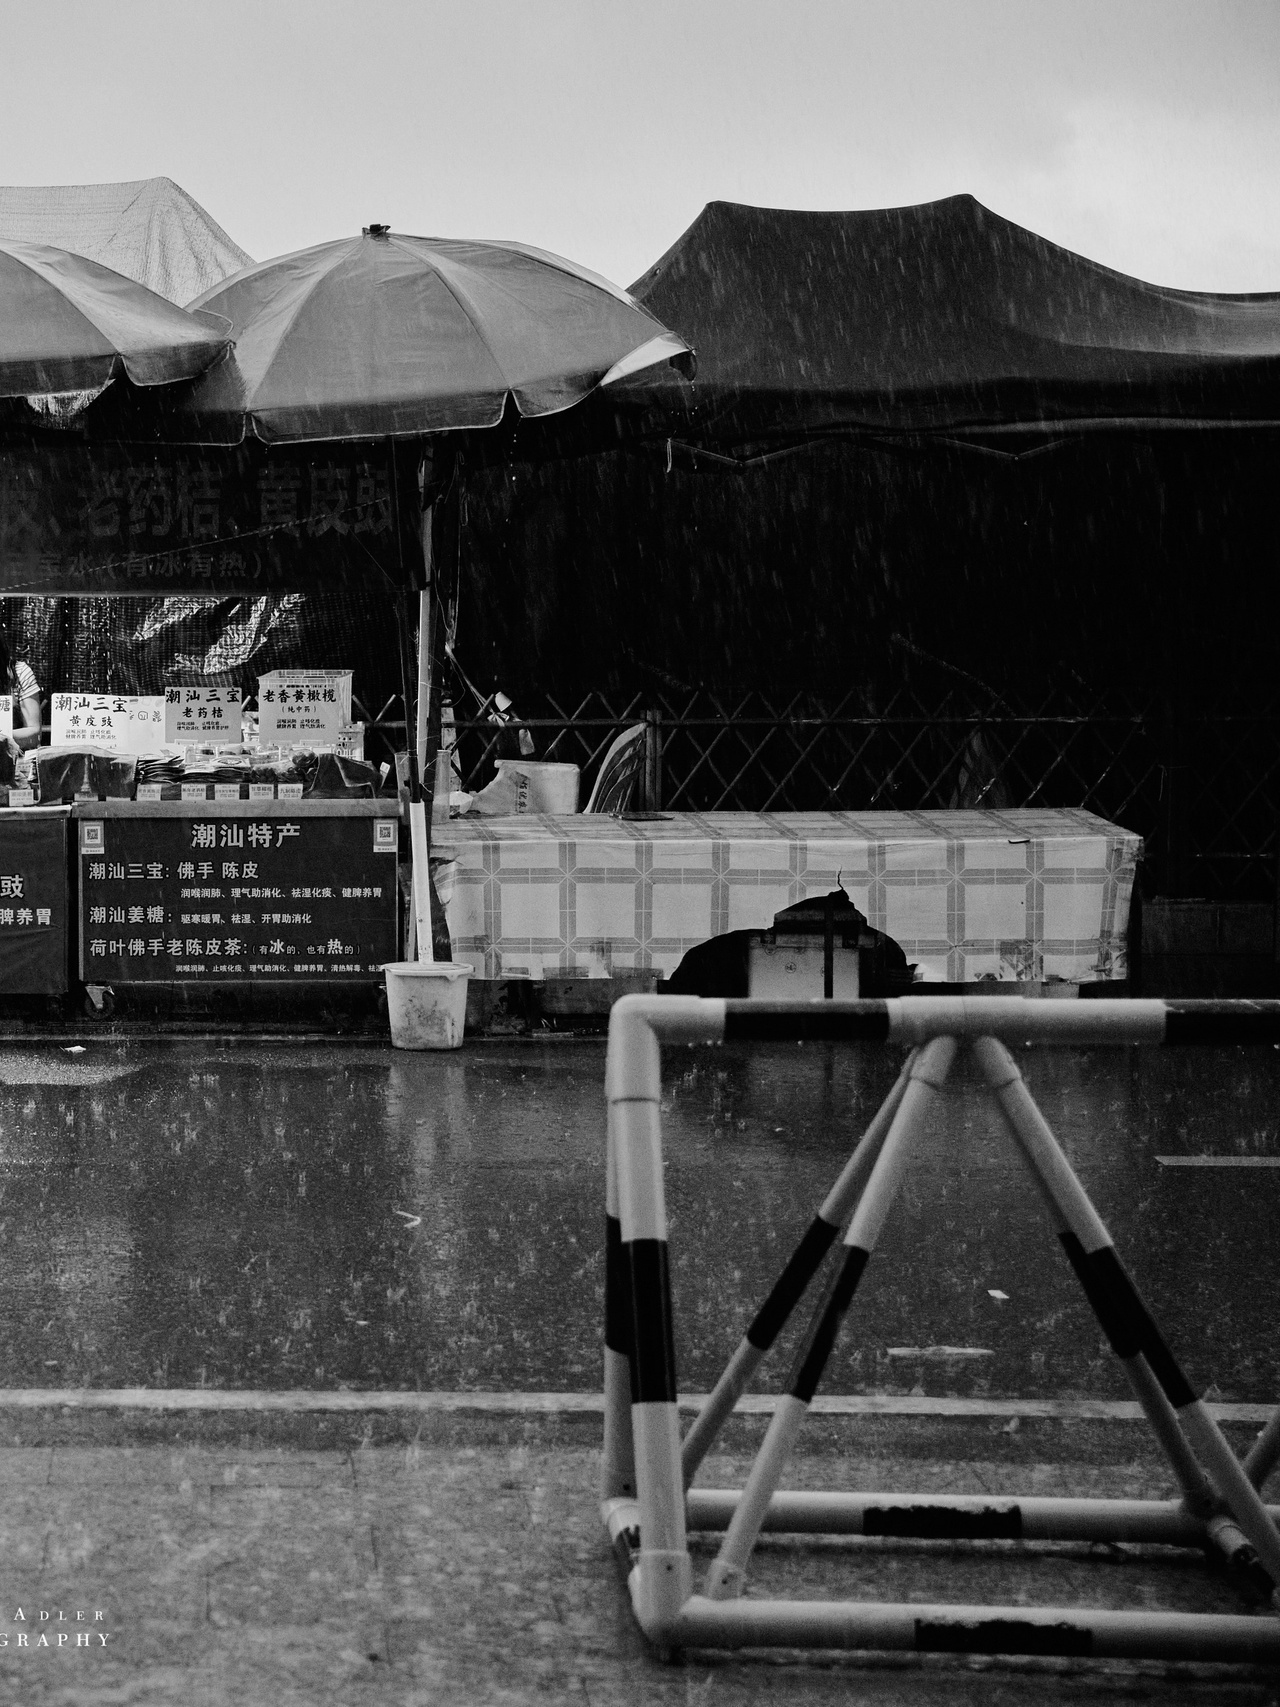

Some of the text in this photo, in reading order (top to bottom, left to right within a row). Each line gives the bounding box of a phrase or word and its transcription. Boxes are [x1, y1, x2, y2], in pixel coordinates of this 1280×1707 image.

[55, 695, 128, 713] 潮汕三宝
[165, 688, 240, 703] 潮汕三宝
[70, 714, 114, 728] 黄皮豉
[182, 707, 224, 718] 老药桔
[191, 823, 301, 848] 潮汕特产
[88, 862, 170, 880] 潮汕三宝:
[180, 887, 382, 899] 润喉润肺、理气助消化、祛湿化痰、健脾养胃
[89, 905, 312, 924] 潮汕姜糖: 驱寒暖胃、祛湿、开胃助消化
[89, 938, 248, 957] 荷叶佛手老陈皮茶:
